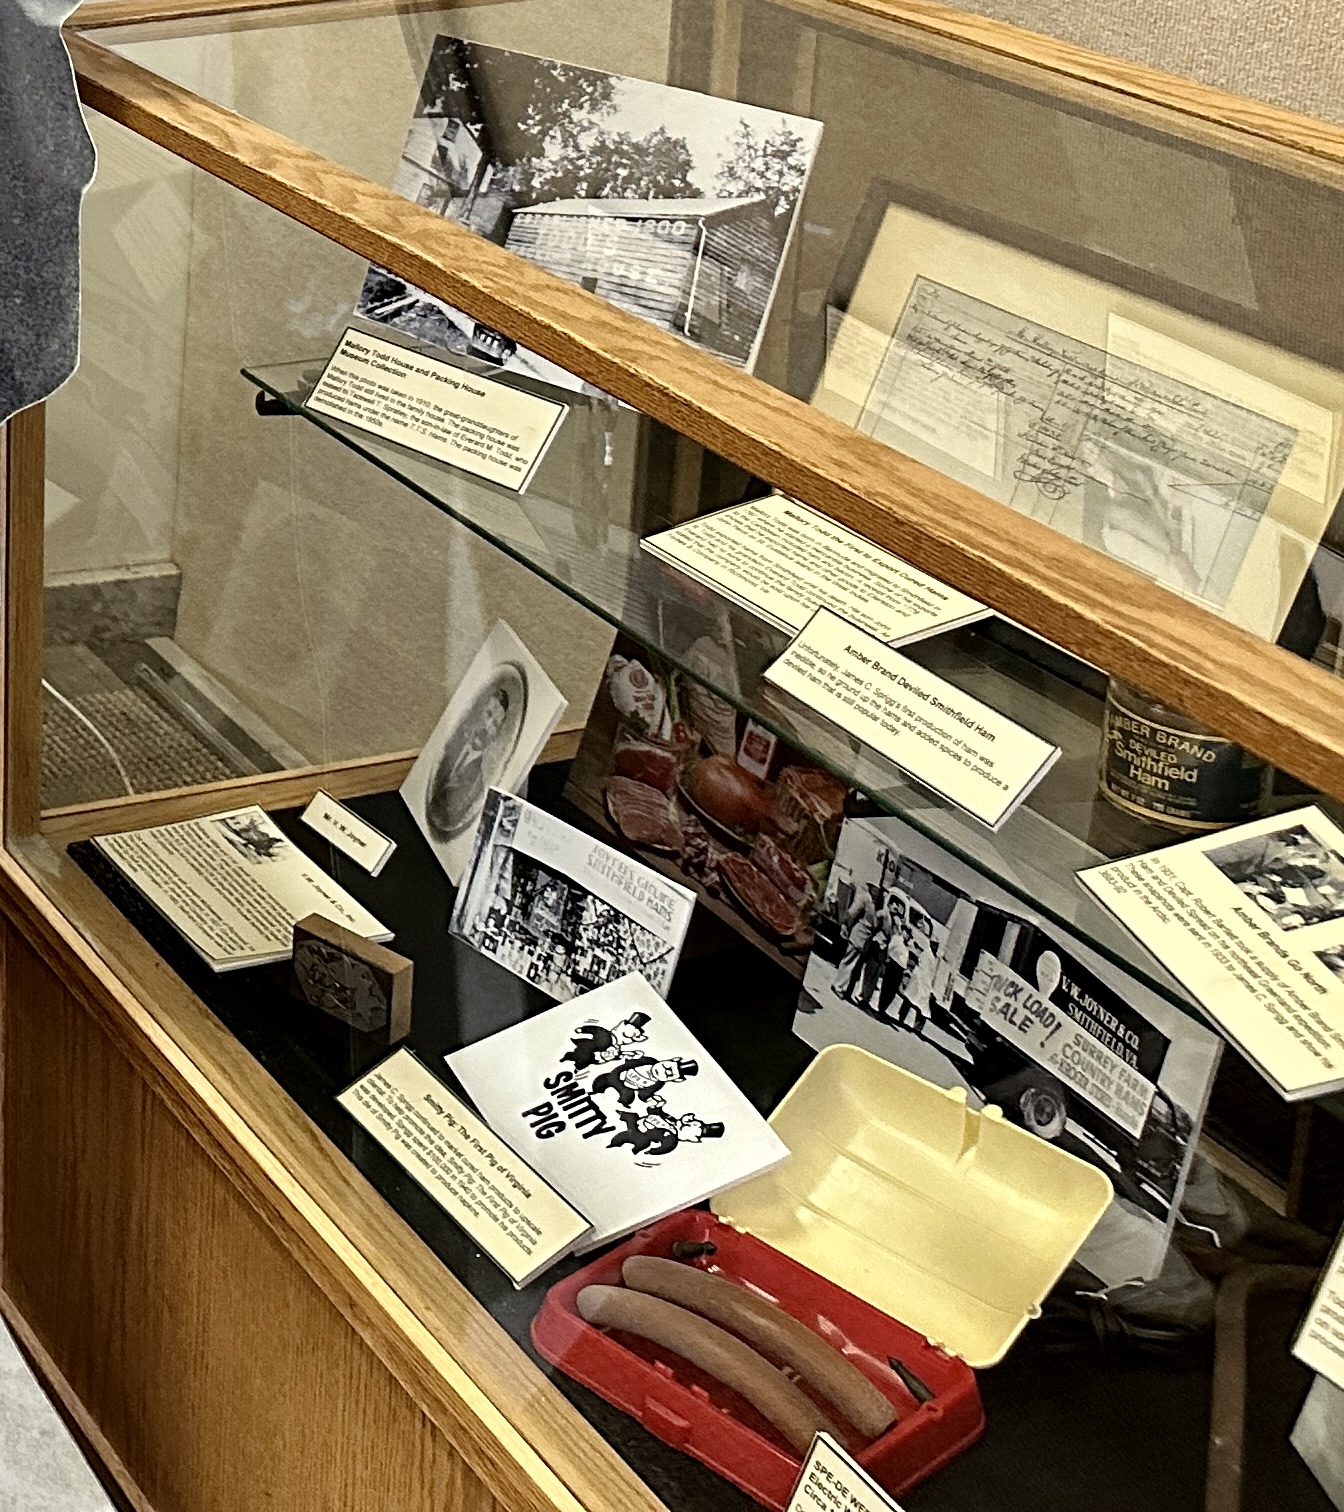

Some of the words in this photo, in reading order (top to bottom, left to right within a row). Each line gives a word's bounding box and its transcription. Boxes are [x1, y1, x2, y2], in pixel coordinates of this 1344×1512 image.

[843, 645, 872, 664] Amber
[871, 661, 898, 681] Brand
[896, 676, 931, 701] Deviled
[929, 696, 975, 728] Smithfield
[973, 724, 995, 742] Ham
[1115, 741, 1198, 783] Smithfield
[1130, 741, 1177, 763] DEVILED
[1156, 732, 1216, 763] BRAND
[1129, 765, 1170, 790] Ham
[522, 1101, 566, 1139] PIG
[543, 1071, 616, 1139] SMITTY
[804, 1484, 827, 1511] Circa
[809, 1472, 842, 1509] Electric
